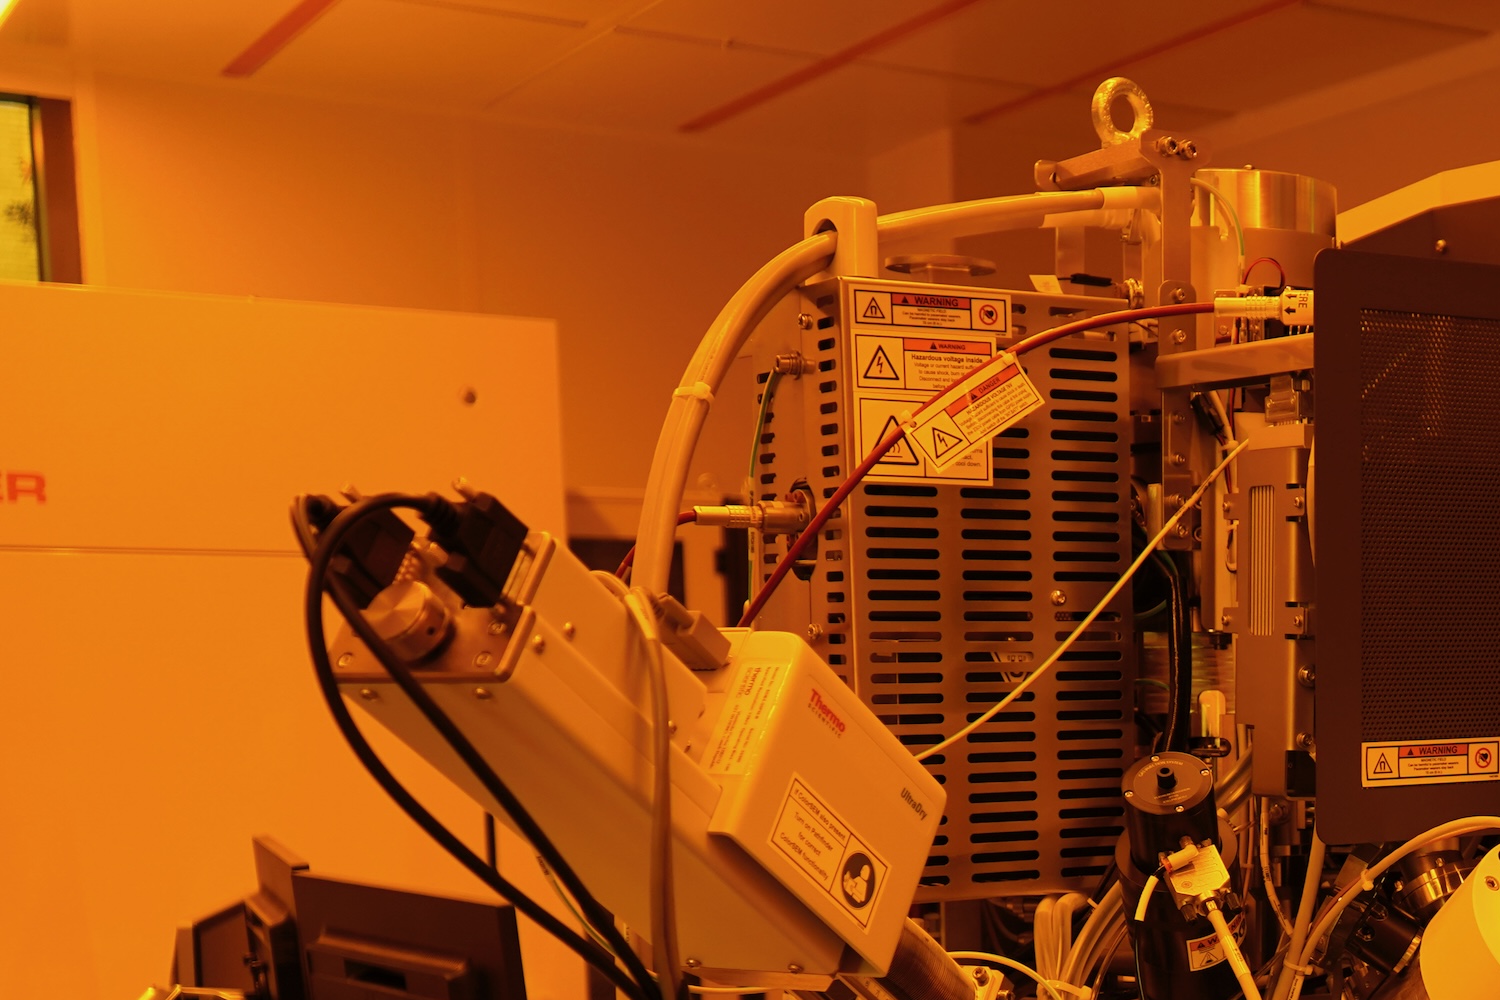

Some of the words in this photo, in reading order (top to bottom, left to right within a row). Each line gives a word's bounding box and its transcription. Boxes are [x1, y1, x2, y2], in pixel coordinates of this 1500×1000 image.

[914, 296, 959, 307] WARNING
[911, 353, 942, 361] Hazardous
[943, 355, 965, 364] voltage
[977, 376, 1000, 393] DANGER
[989, 386, 1006, 399] VOLTAGE
[0, 473, 46, 503] R
[744, 667, 762, 696] thermo
[808, 703, 841, 739] SCIENTIFIC
[811, 688, 846, 733] Thermo
[1419, 745, 1458, 755] WARNING
[793, 811, 806, 824] Turn
[795, 791, 820, 815] ColorSEM
[818, 813, 830, 825] also
[828, 822, 846, 840] present
[900, 787, 928, 821] UltraDry
[779, 831, 803, 855] ColorSEM
[800, 852, 829, 880] functionality
[796, 831, 806, 841] for
[804, 839, 821, 856] correct
